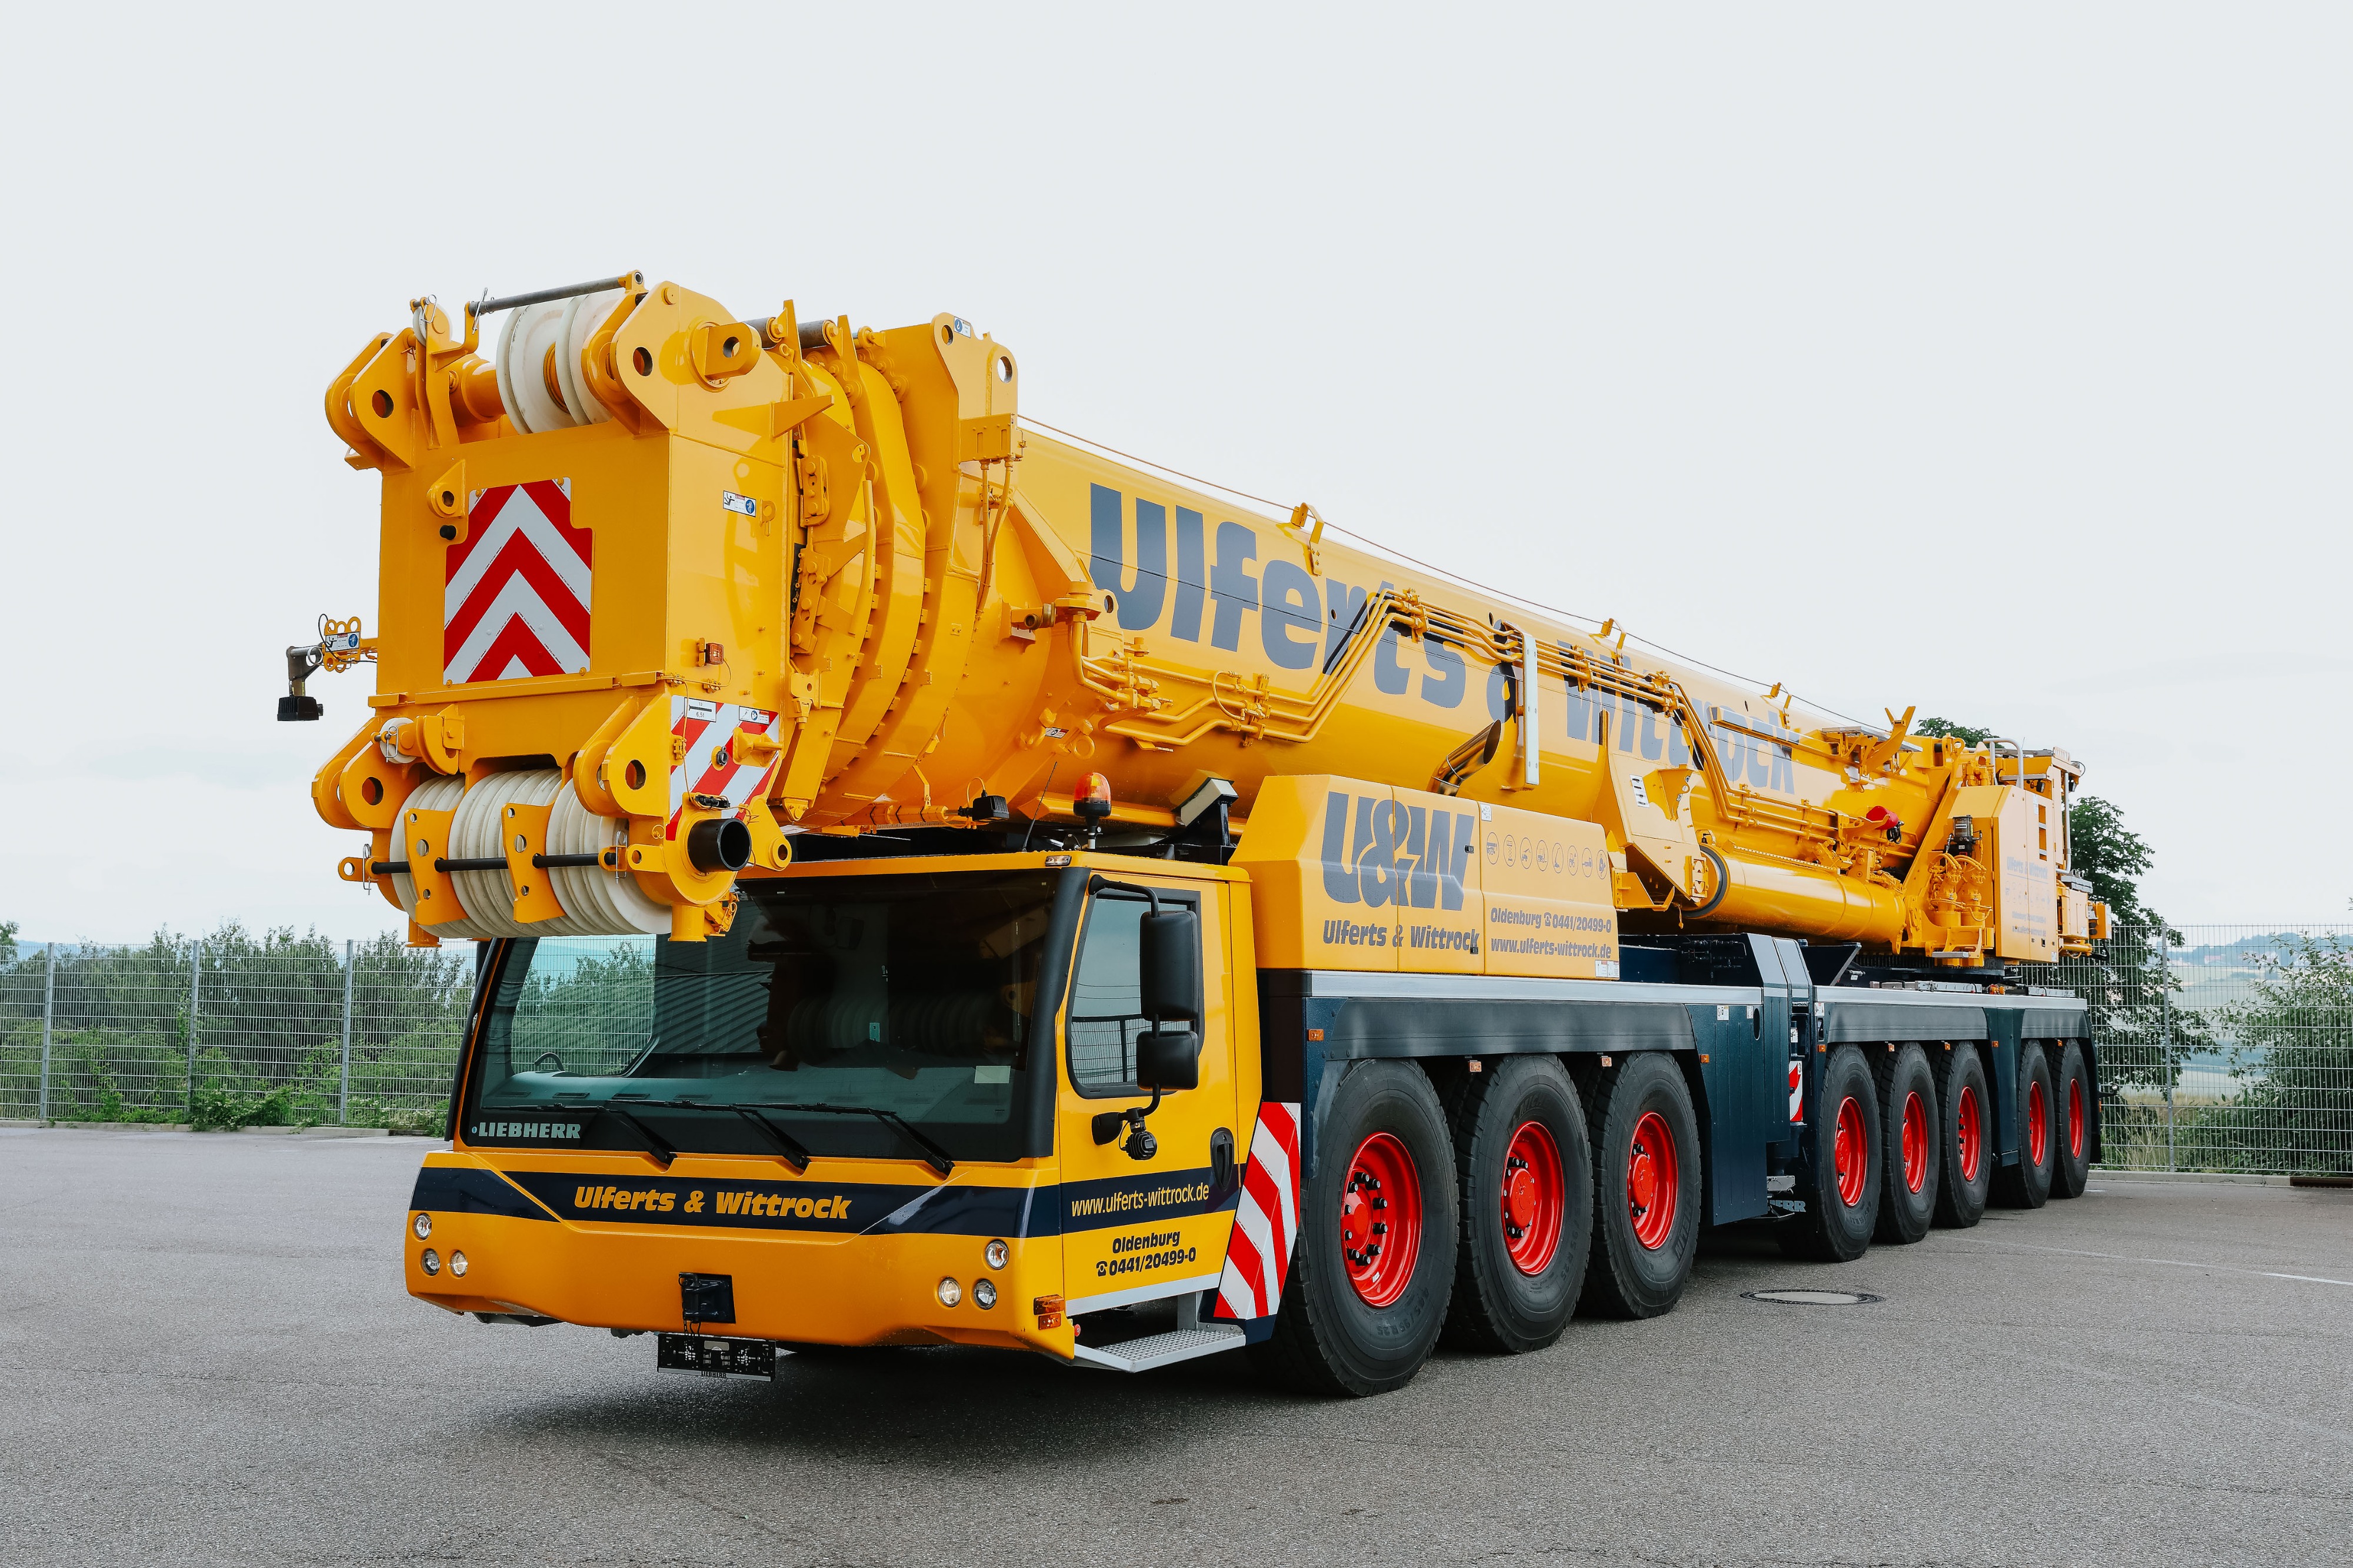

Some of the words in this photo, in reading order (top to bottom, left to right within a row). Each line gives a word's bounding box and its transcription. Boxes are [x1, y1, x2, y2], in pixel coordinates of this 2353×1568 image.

[1089, 482, 1466, 709] Ulferts
[1321, 791, 1475, 911] U&W
[1323, 919, 1387, 946] Ulferts
[1392, 924, 1404, 948] &
[1411, 925, 1480, 951] Wittrock
[1491, 908, 1542, 929] Oldenburg
[1552, 914, 1612, 933] 0441/20499-0
[1491, 938, 1612, 959] www.ulferts-wittrock.de
[479, 1122, 581, 1139] LIEBHERR
[574, 1186, 676, 1212] Ulferts
[684, 1190, 706, 1213] &
[716, 1191, 852, 1219] Wittrock
[1071, 1182, 1209, 1217] www.ulferts-wittrock.de
[1112, 1231, 1181, 1254] Oldenburg
[1109, 1247, 1197, 1276] 0441/20499-0
